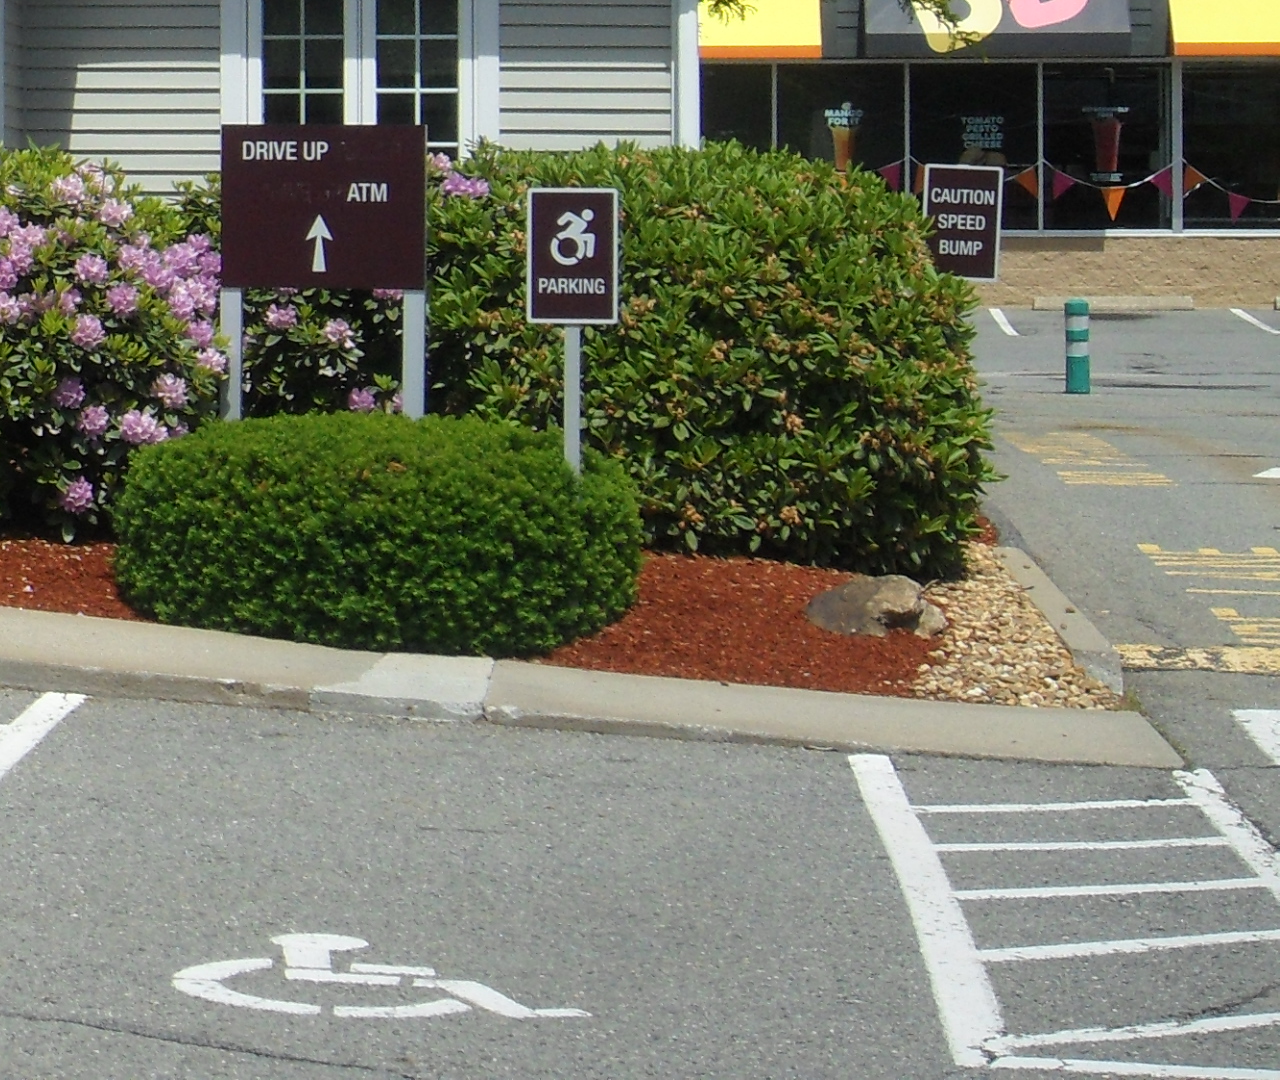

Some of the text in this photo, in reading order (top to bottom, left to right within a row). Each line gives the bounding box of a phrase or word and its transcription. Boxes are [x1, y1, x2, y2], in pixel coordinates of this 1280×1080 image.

[242, 141, 329, 161] DRIVE UP
[347, 183, 388, 203] ATM
[931, 187, 996, 206] CAUTION
[938, 213, 987, 231] SPEED
[939, 239, 983, 256] BUMP
[538, 277, 606, 295] PARKING
